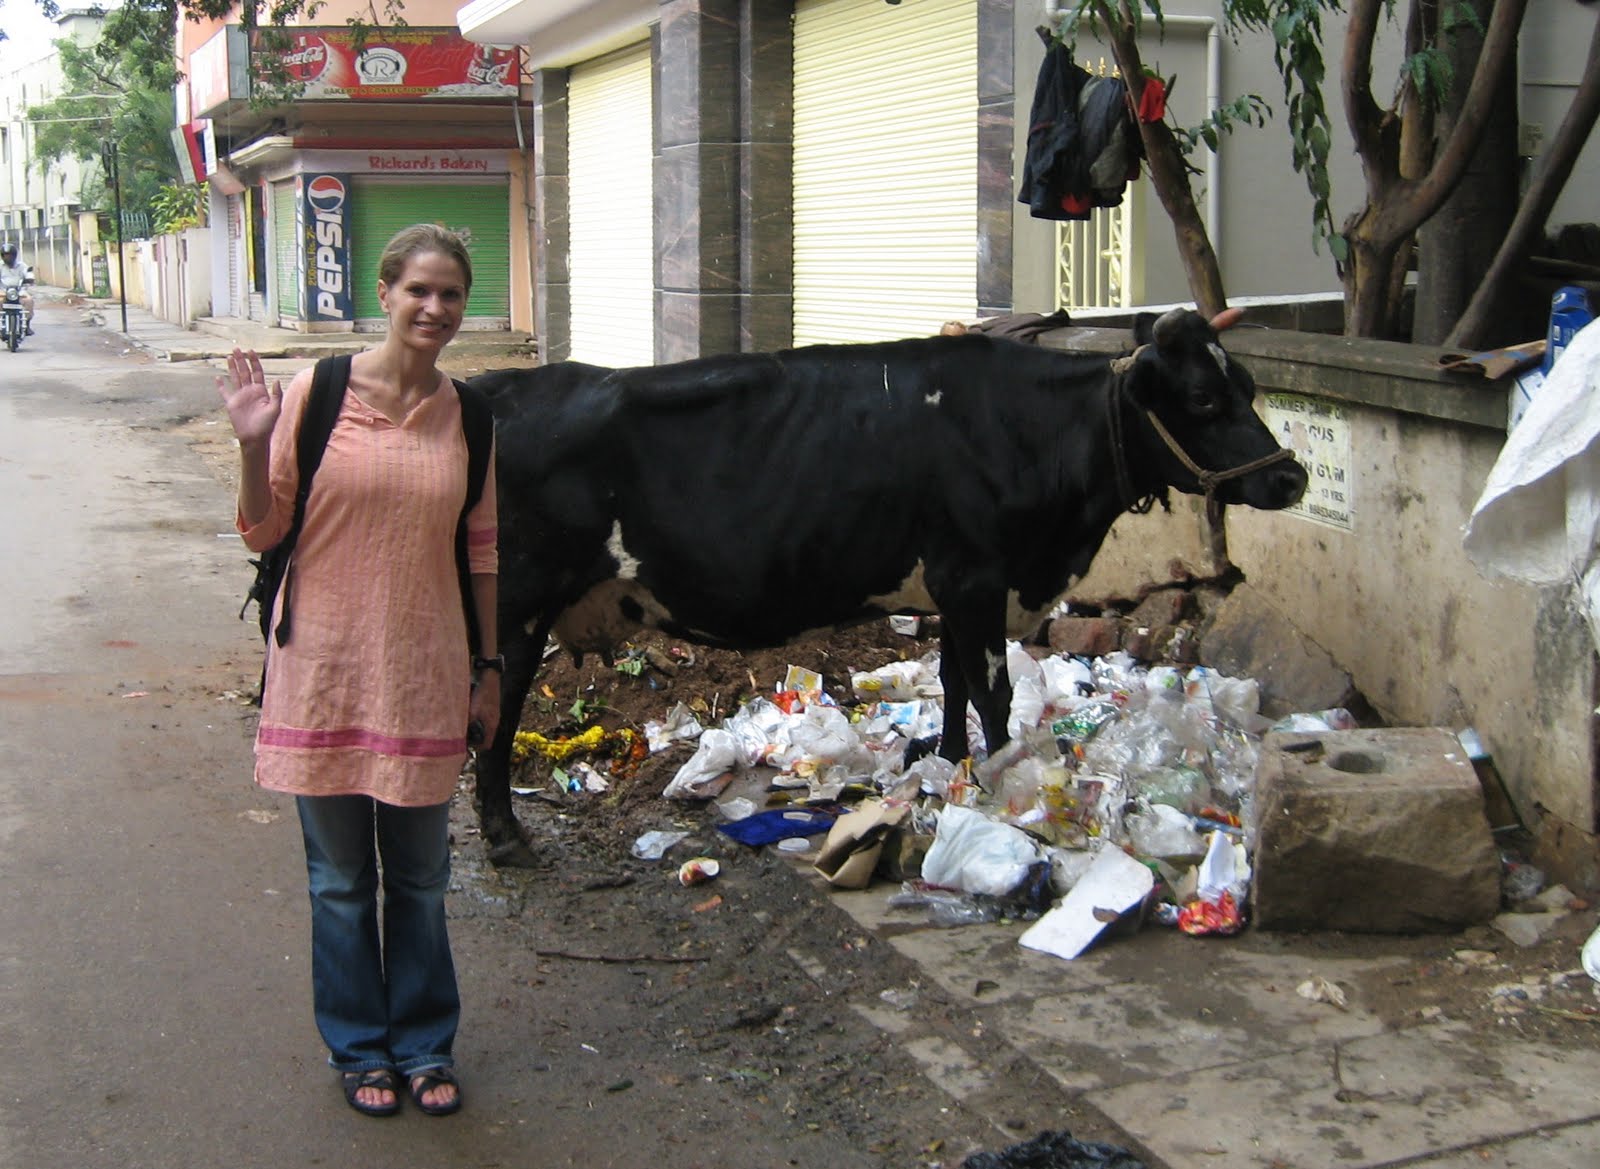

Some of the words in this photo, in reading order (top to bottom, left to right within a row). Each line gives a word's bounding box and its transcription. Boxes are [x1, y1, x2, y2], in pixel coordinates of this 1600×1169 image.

[323, 87, 357, 95] BAKERY
[368, 155, 435, 170] Richard's
[440, 156, 488, 171] Bakery
[316, 212, 343, 318] PEPSI
